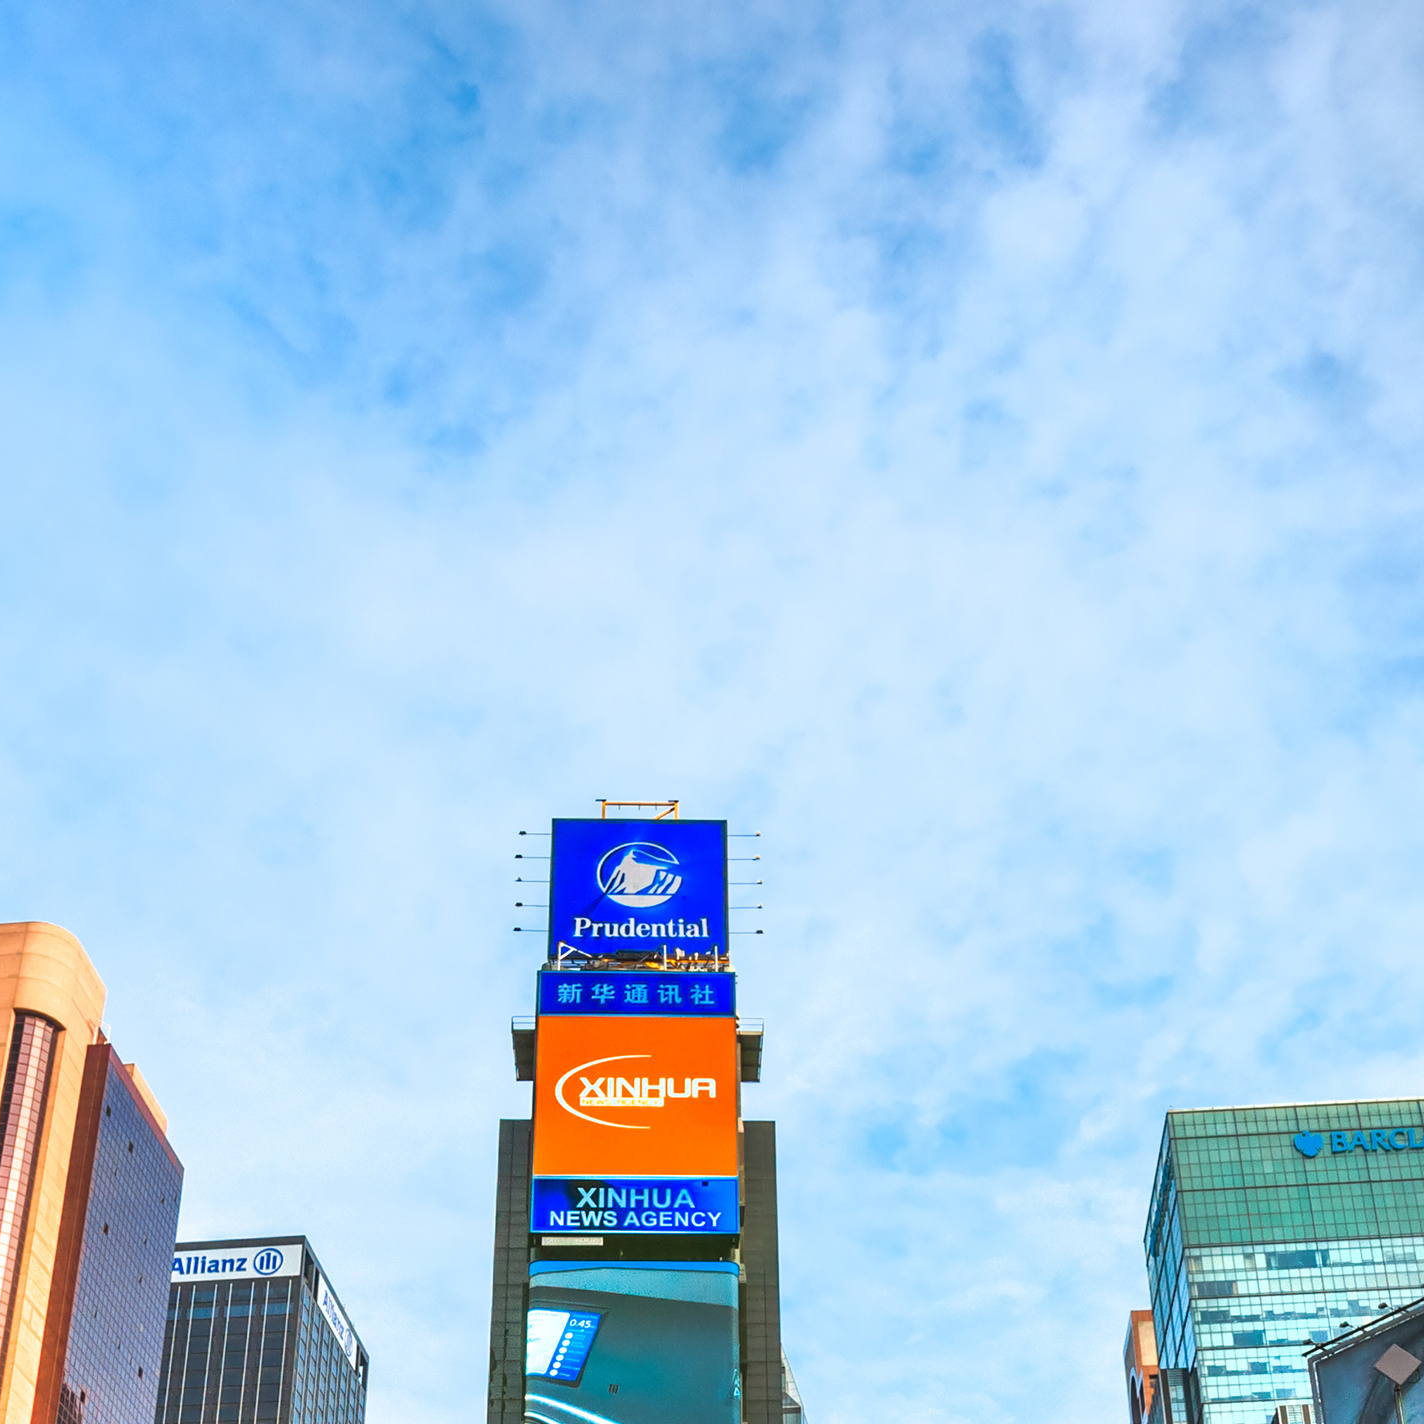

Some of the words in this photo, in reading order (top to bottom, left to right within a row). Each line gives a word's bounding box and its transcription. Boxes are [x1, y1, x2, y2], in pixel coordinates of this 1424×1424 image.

[573, 917, 710, 940] Prudential
[557, 983, 716, 1006] 新华通讯社
[579, 1077, 716, 1098] XINHUA
[576, 1187, 695, 1209] XINHUA
[550, 1210, 617, 1226] NEWS
[623, 1211, 722, 1229] AGENCY
[171, 1255, 247, 1275] Allianz
